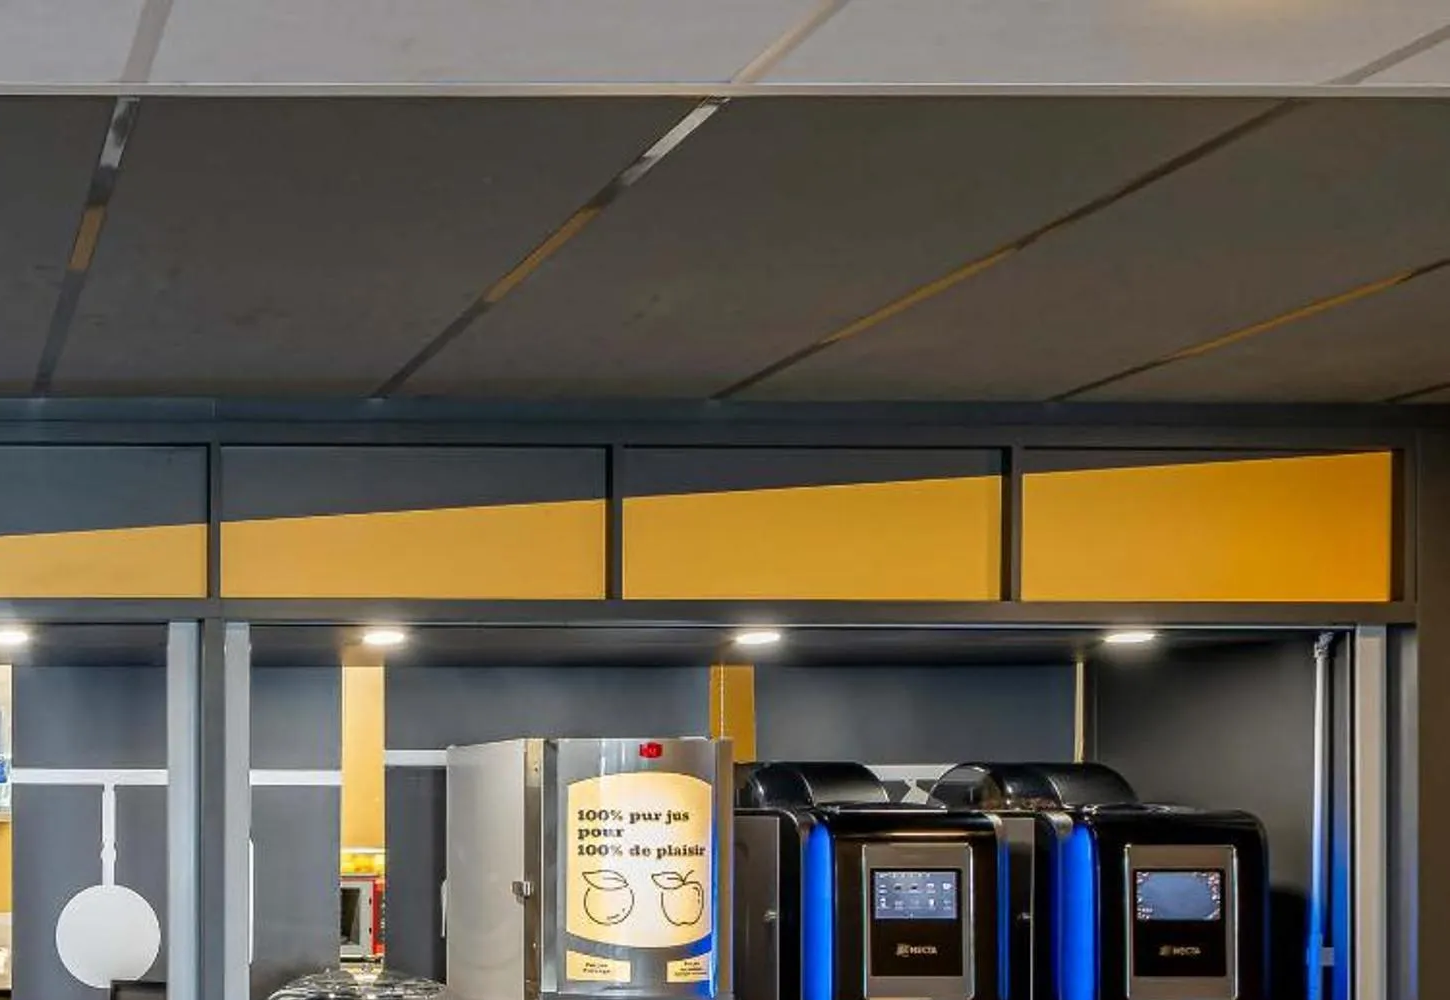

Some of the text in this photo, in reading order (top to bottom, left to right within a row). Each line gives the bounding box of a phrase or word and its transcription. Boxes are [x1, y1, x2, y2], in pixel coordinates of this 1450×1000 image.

[577, 809, 690, 825] 100% pur jus
[577, 828, 624, 840] pour
[577, 844, 706, 859] 100% de plaisir
